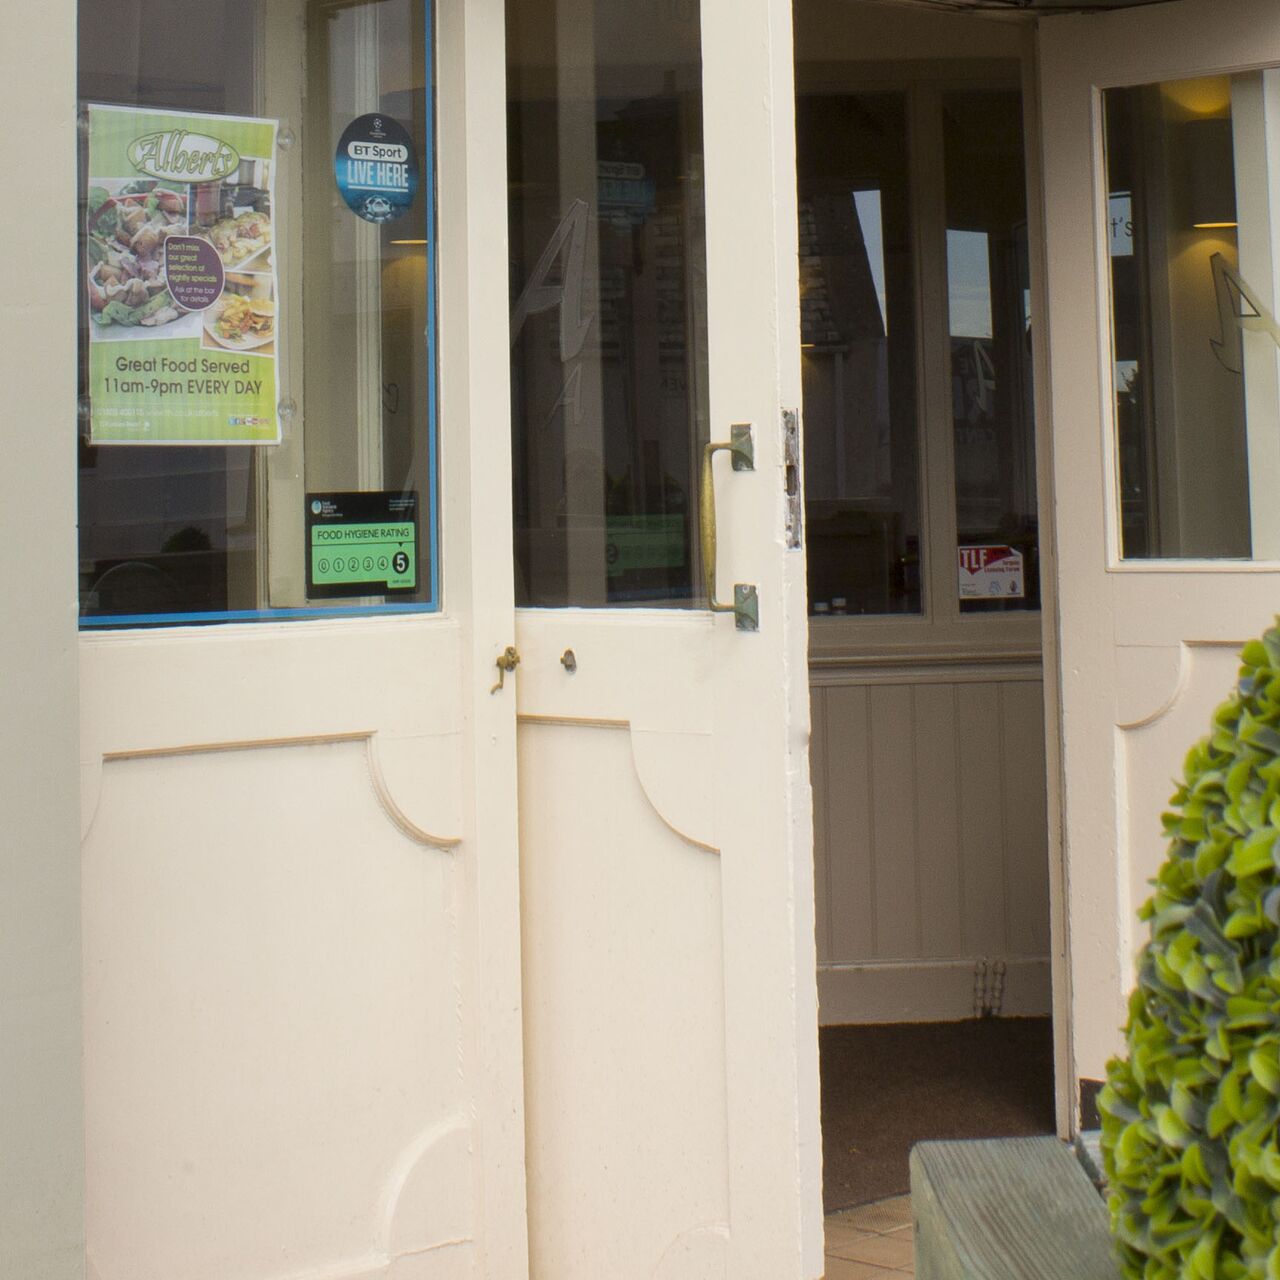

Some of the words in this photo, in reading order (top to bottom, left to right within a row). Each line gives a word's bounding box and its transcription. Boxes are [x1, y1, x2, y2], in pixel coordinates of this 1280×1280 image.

[136, 128, 232, 177] Alberts
[354, 145, 371, 156] BT
[372, 145, 402, 159] Sport
[347, 159, 374, 185] LIVE
[376, 162, 409, 188] HERE
[115, 356, 157, 372] Great
[161, 358, 197, 373] Food
[201, 358, 250, 374] Served
[104, 377, 183, 397] 11am-9pm
[187, 380, 230, 395] EVERY
[234, 380, 263, 395] DAY
[317, 530, 343, 540] FOOD
[344, 528, 380, 539] HYGIENE
[380, 527, 410, 538] RATING
[395, 553, 406, 572] 5
[960, 548, 987, 569] TLF
